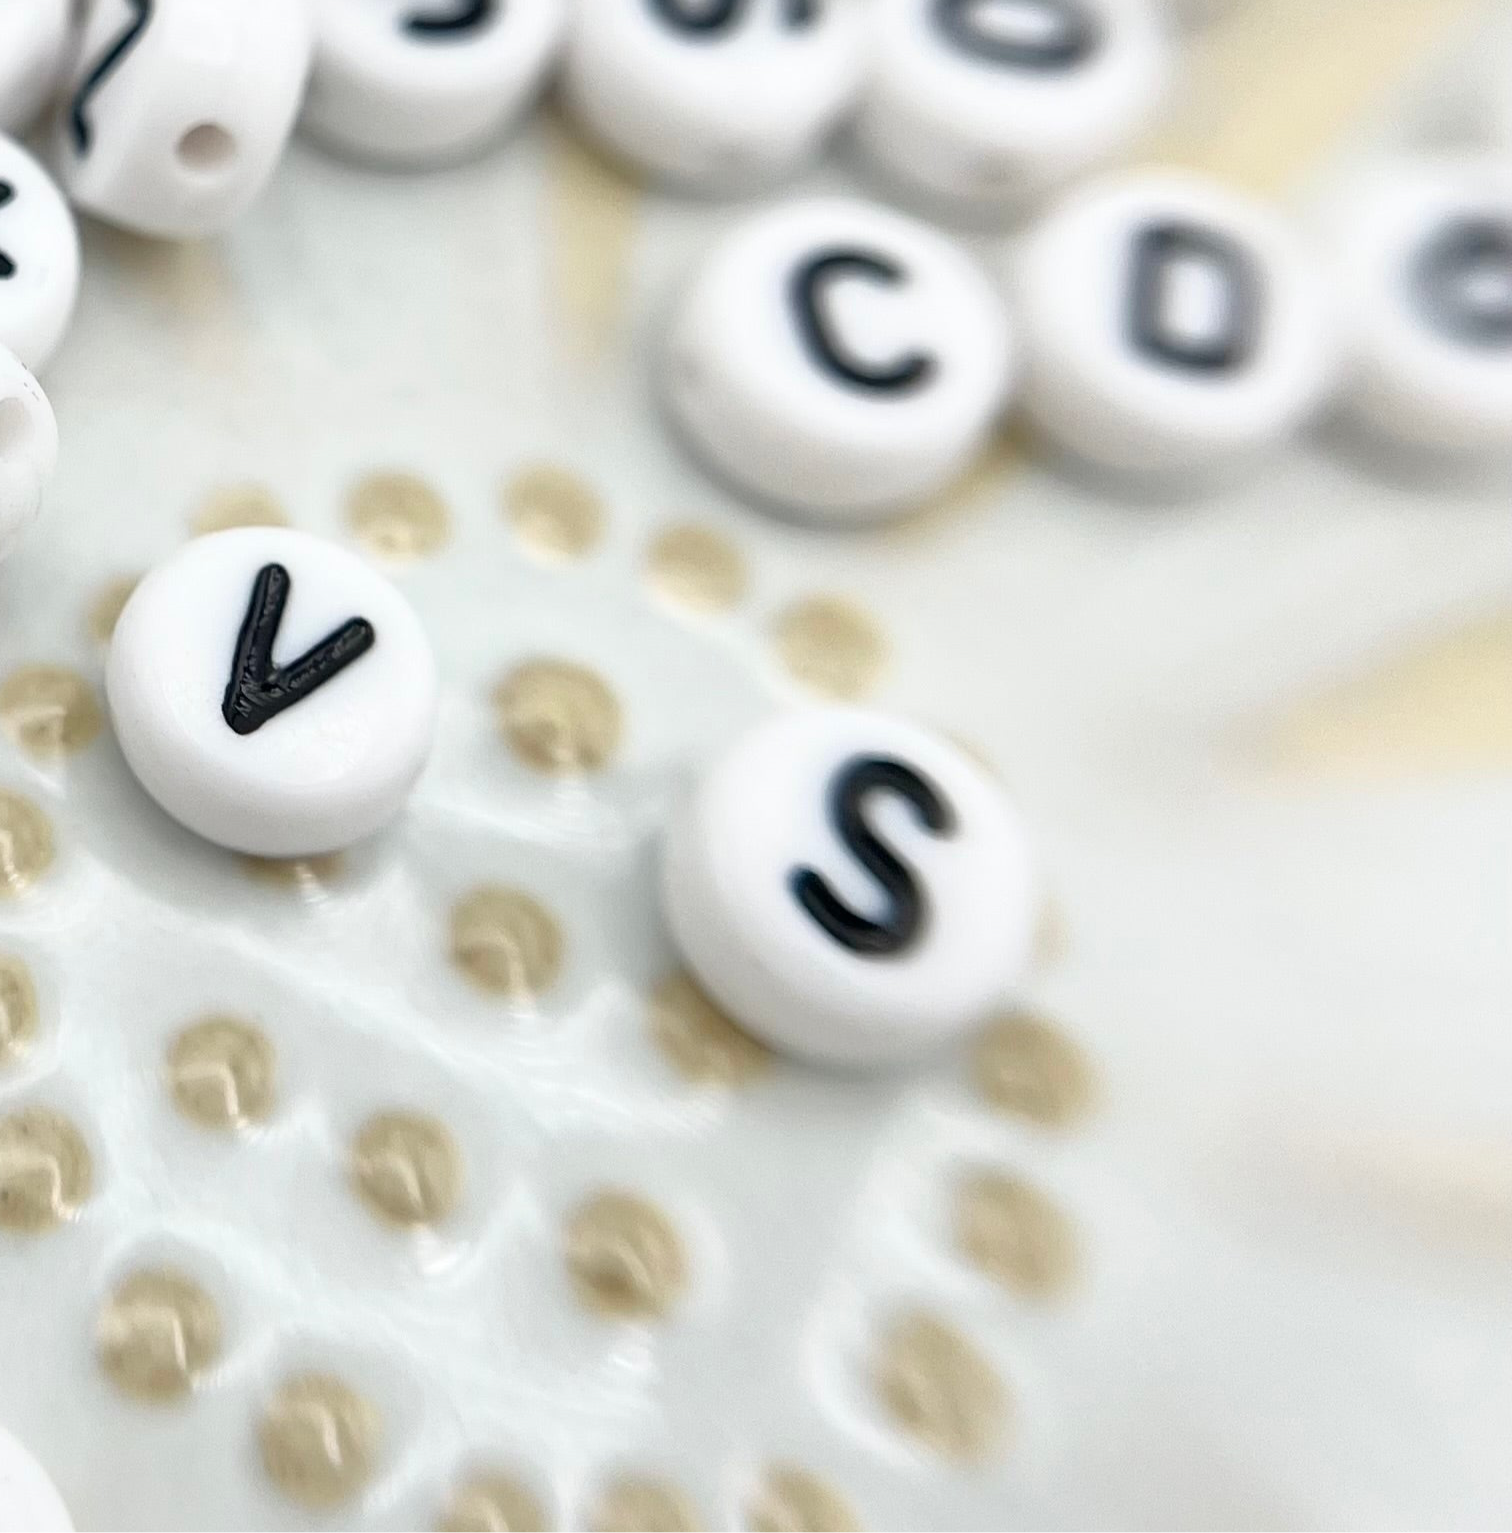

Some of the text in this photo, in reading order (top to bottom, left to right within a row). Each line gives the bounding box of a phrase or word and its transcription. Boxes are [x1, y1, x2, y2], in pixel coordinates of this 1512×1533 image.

[787, 245, 935, 399] C
[1126, 222, 1252, 379] D
[220, 562, 377, 737] V
[786, 753, 956, 961] S
